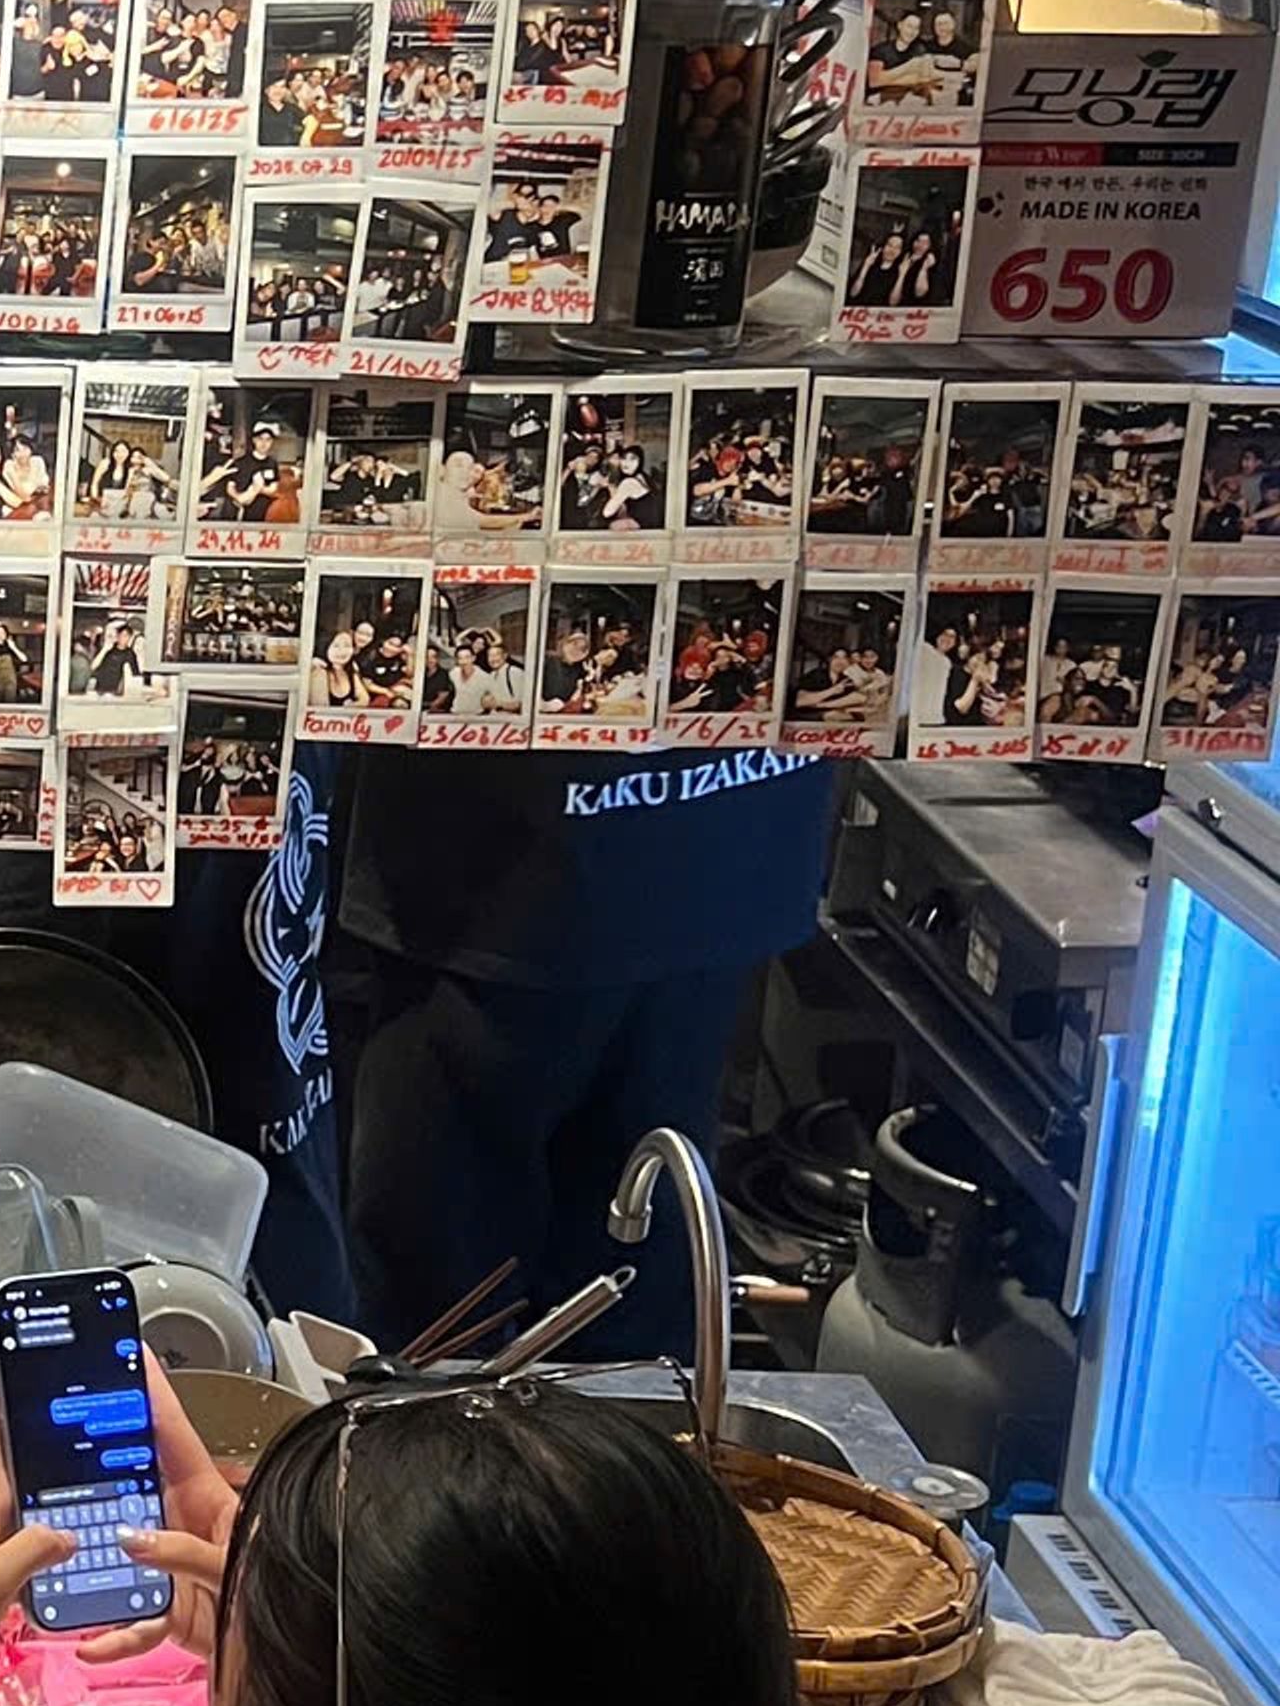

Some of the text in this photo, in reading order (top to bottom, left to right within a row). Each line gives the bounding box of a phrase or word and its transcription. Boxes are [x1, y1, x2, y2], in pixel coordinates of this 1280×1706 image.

[1020, 201, 1201, 220] MADE IN KOREA
[990, 247, 1174, 325] 650
[302, 715, 372, 740] Family
[565, 773, 670, 817] KAKU
